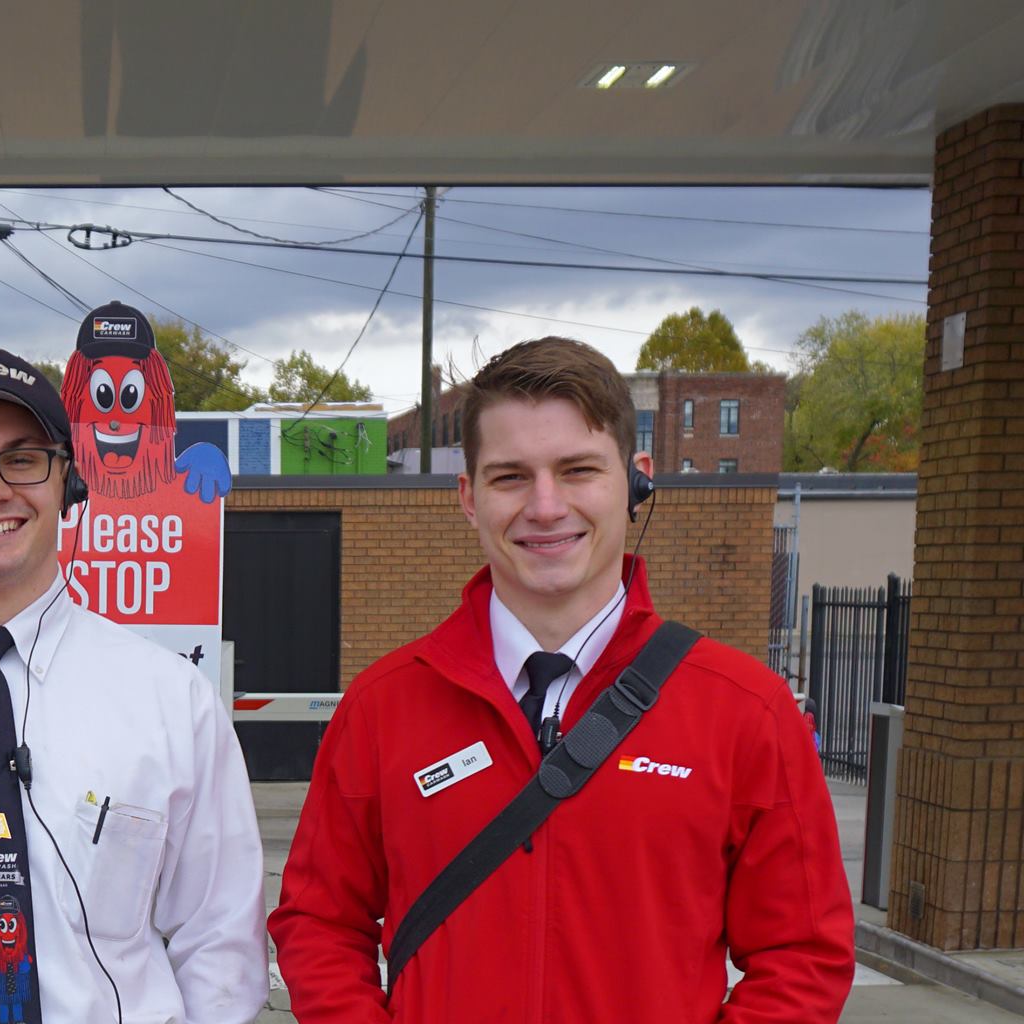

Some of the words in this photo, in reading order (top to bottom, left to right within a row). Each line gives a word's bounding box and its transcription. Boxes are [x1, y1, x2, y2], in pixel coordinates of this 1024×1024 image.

[101, 321, 132, 331] Crew
[57, 500, 183, 553] Please
[65, 560, 171, 615] STOP
[461, 755, 477, 768] Ian
[632, 757, 693, 779] Crew
[423, 766, 450, 783] Crew
